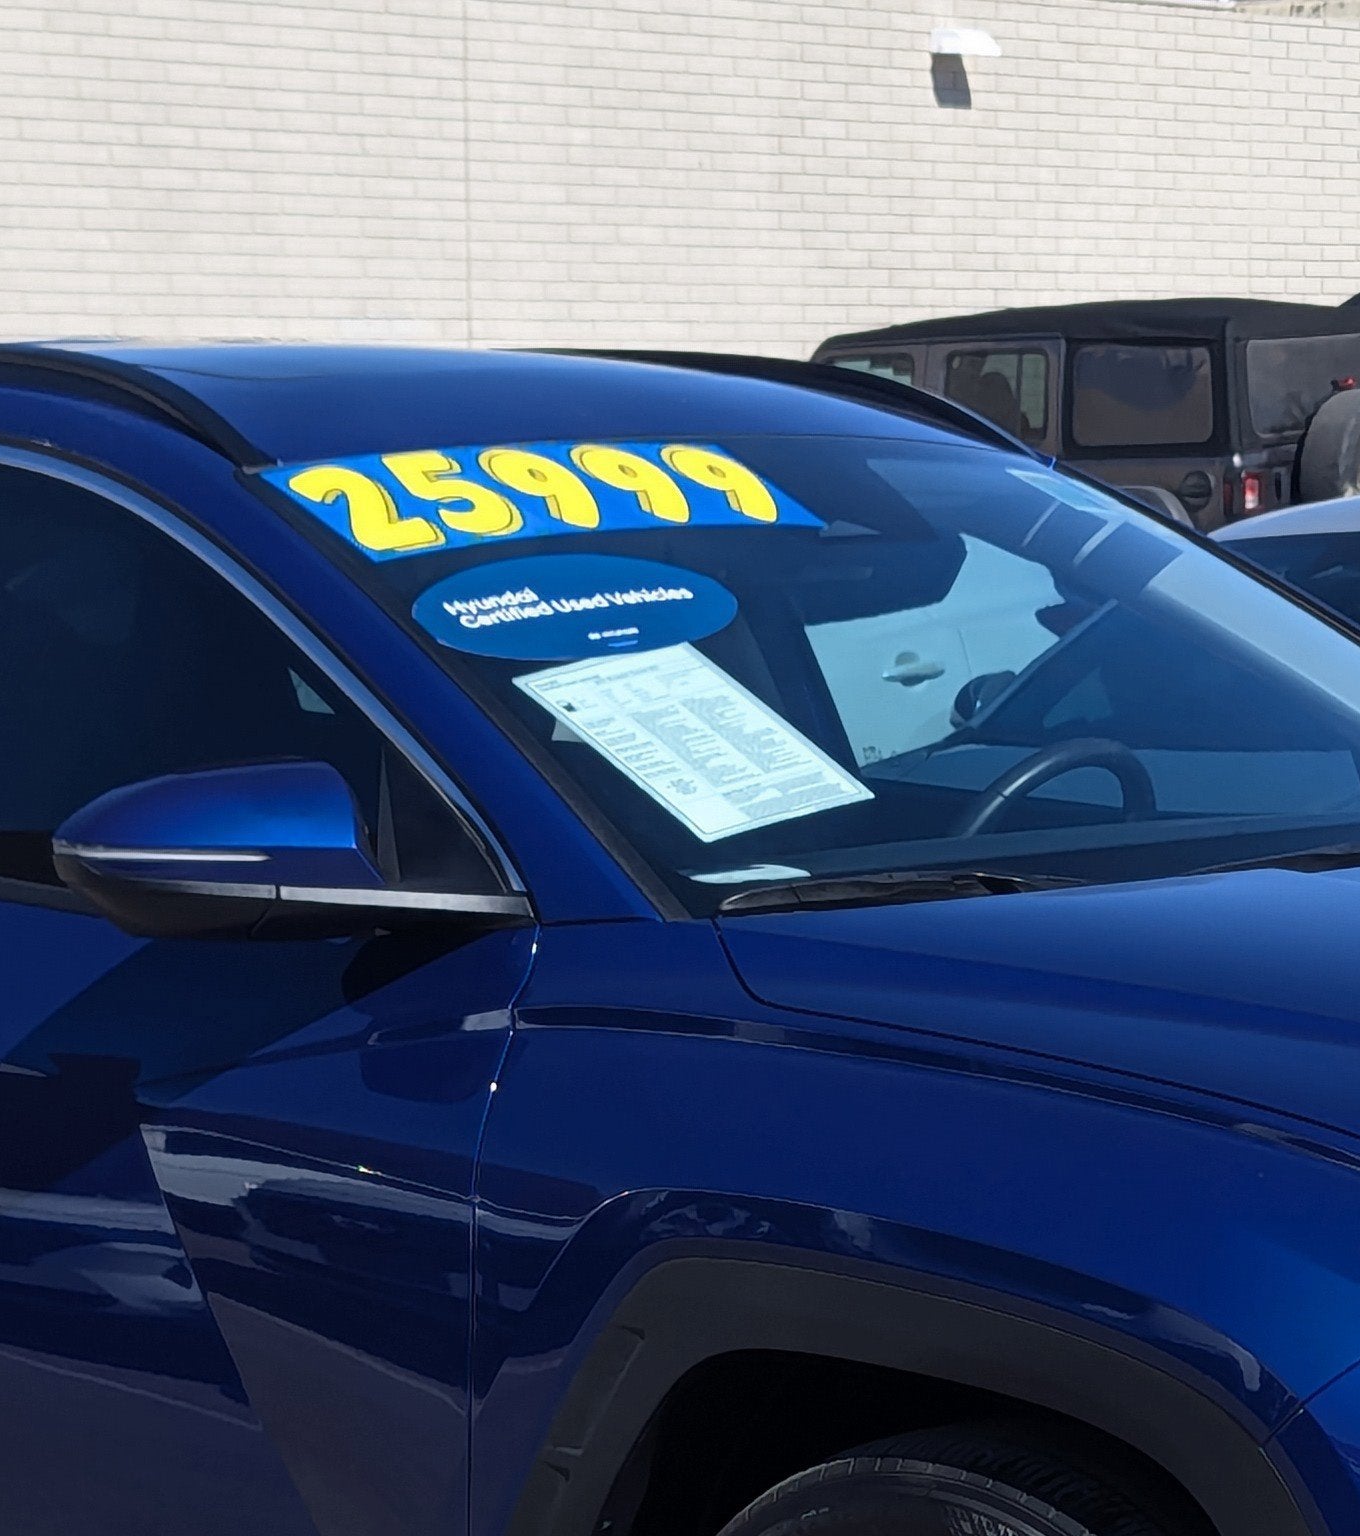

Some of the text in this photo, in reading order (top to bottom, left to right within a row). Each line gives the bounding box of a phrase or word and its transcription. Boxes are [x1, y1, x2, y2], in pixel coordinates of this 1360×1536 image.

[287, 445, 778, 552] 25999
[443, 586, 539, 616] Hyundai
[459, 586, 694, 629] Certified Used Vehicles
